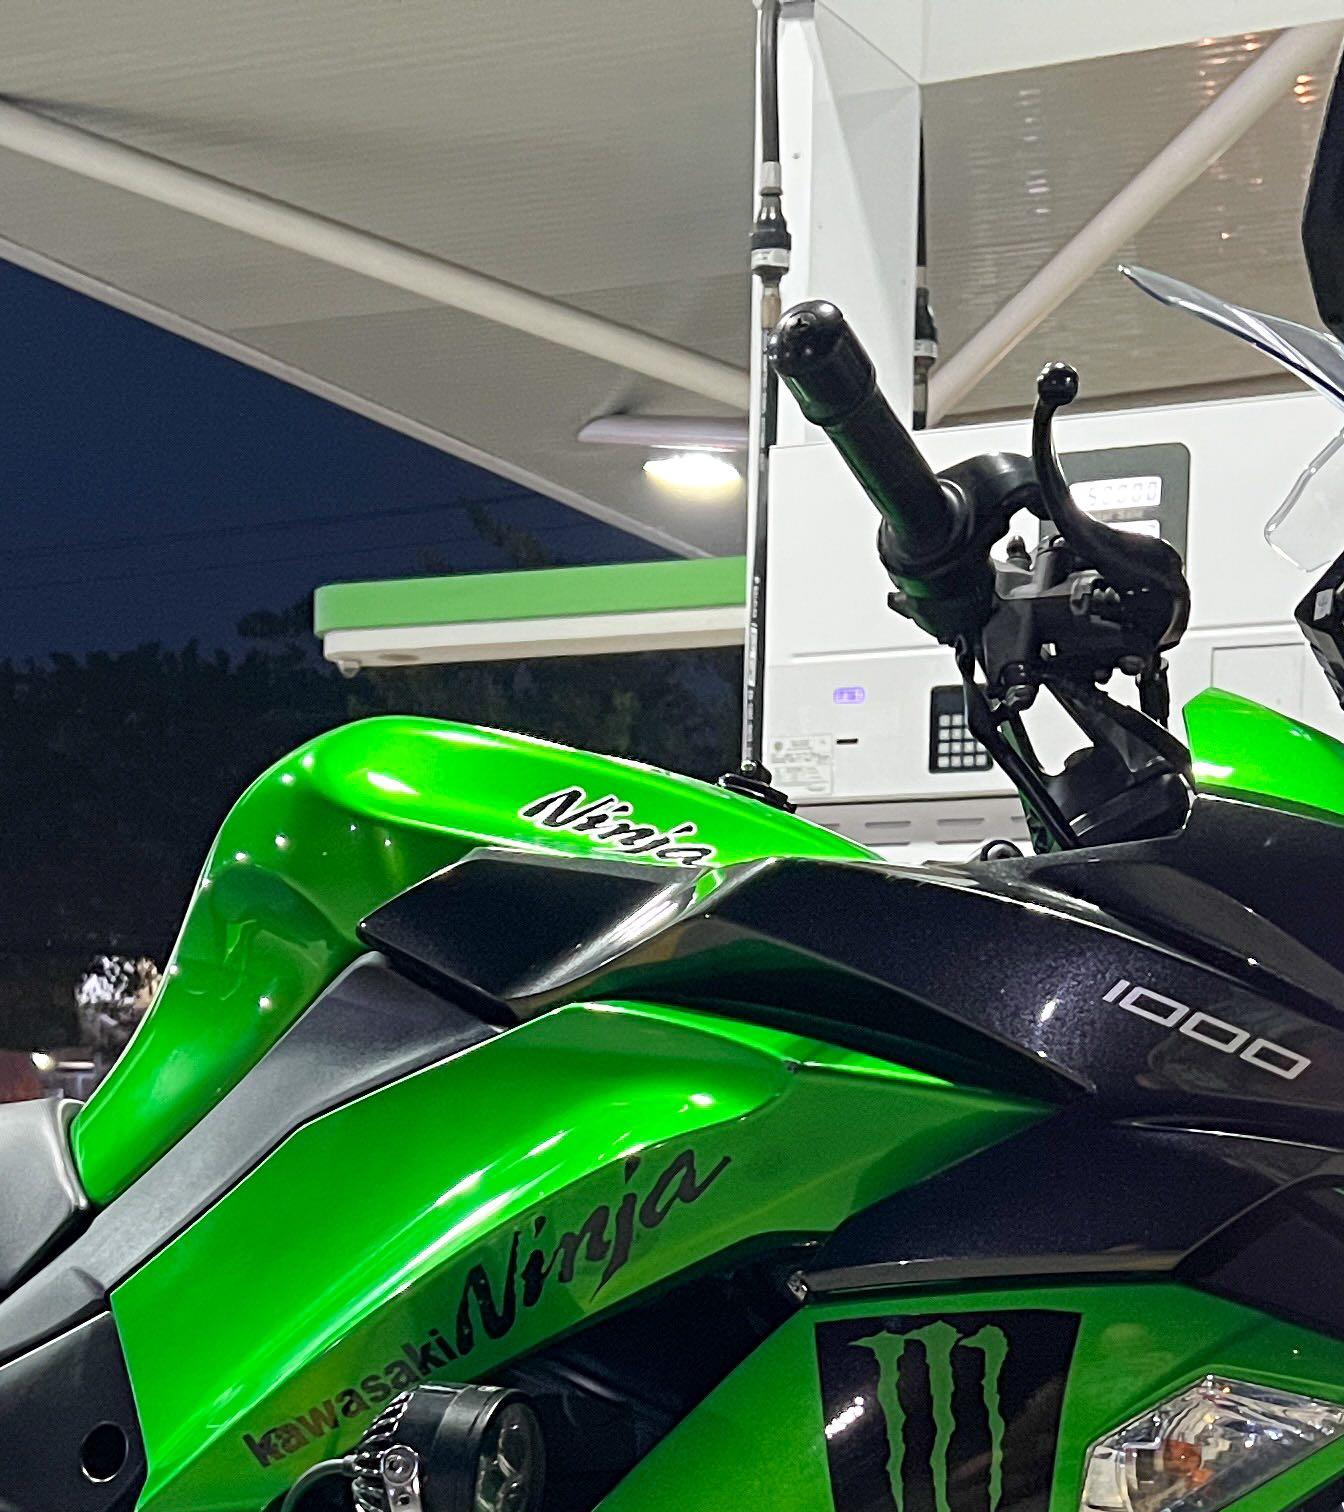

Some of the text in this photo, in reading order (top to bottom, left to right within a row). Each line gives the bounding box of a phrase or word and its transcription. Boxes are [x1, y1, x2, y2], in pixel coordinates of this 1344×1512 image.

[520, 787, 719, 868] Ninja
[1102, 979, 1311, 1080] 1000
[457, 1149, 732, 1356] Ninja
